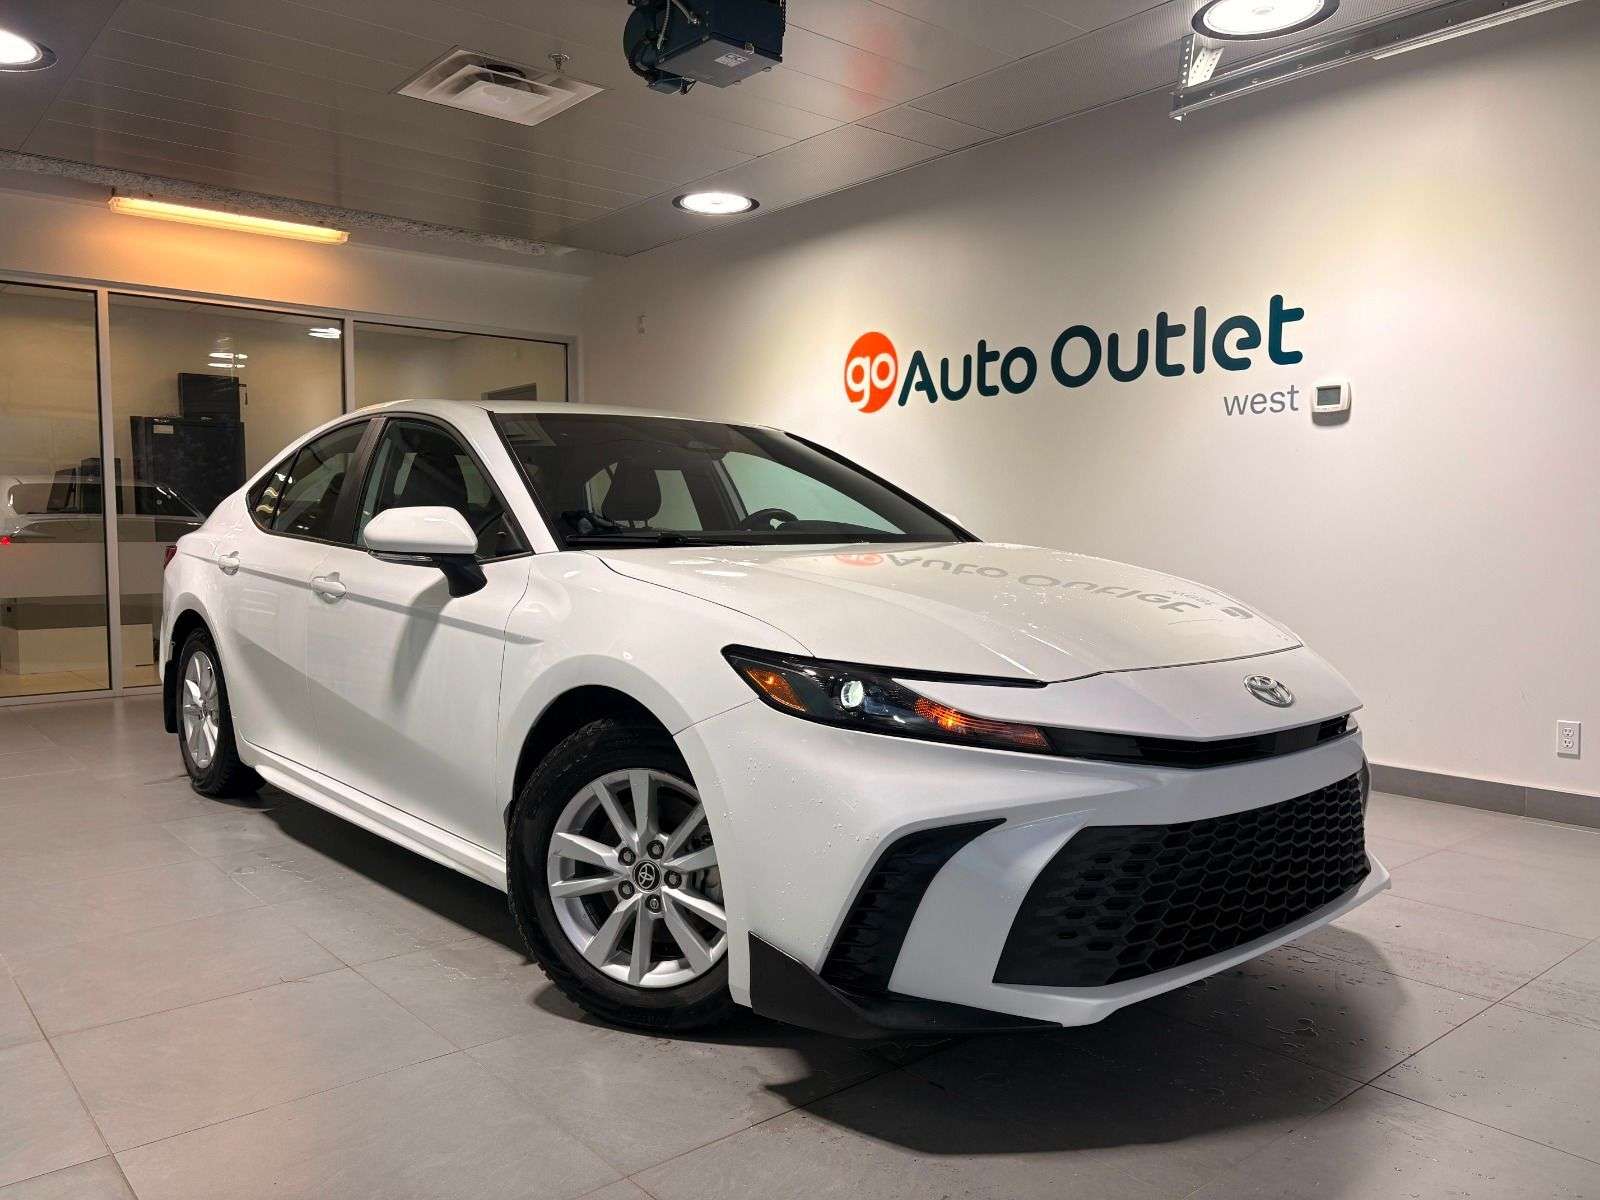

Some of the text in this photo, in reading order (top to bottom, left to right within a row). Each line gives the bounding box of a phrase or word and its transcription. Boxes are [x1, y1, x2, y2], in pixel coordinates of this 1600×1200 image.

[845, 294, 1305, 410] go Auto Outlet
[1223, 384, 1300, 416] west
